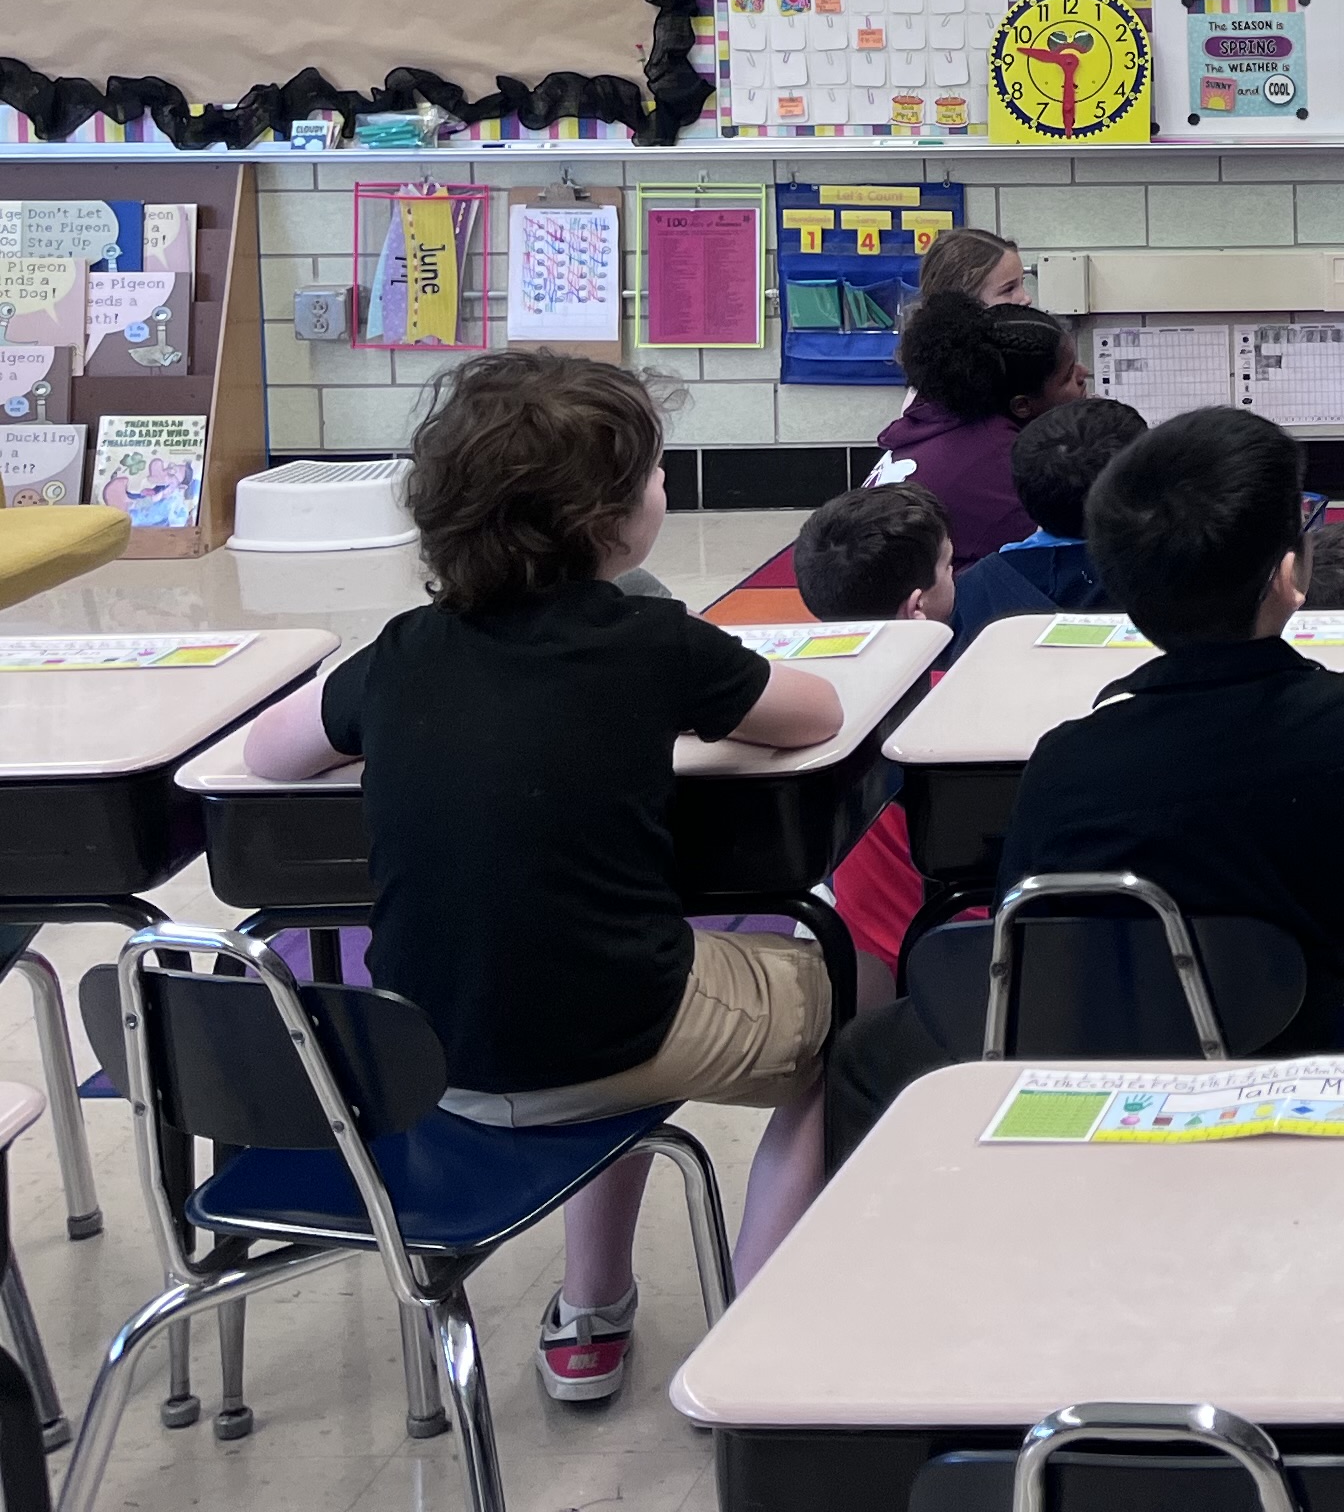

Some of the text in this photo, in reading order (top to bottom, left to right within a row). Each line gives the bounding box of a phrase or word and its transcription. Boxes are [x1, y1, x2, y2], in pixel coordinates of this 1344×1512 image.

[1208, 20, 1283, 31] The SEASON is
[1220, 39, 1276, 55] SPRING
[1205, 63, 1290, 73] The WEATHER is
[1205, 81, 1290, 97] SUNNY and COOL
[837, 190, 903, 201] Let's Count
[29, 208, 102, 219] Don't Let
[28, 222, 110, 237] the Pigeon
[28, 237, 91, 251] Stay Up
[8, 262, 66, 273] Pigeon
[420, 243, 445, 294] June
[112, 278, 165, 292] Pigeon
[20, 288, 56, 300] Dog!
[7, 433, 75, 445] Duckling
[167, 429, 189, 437] WHO
[1238, 1082, 1297, 1101] Talia
